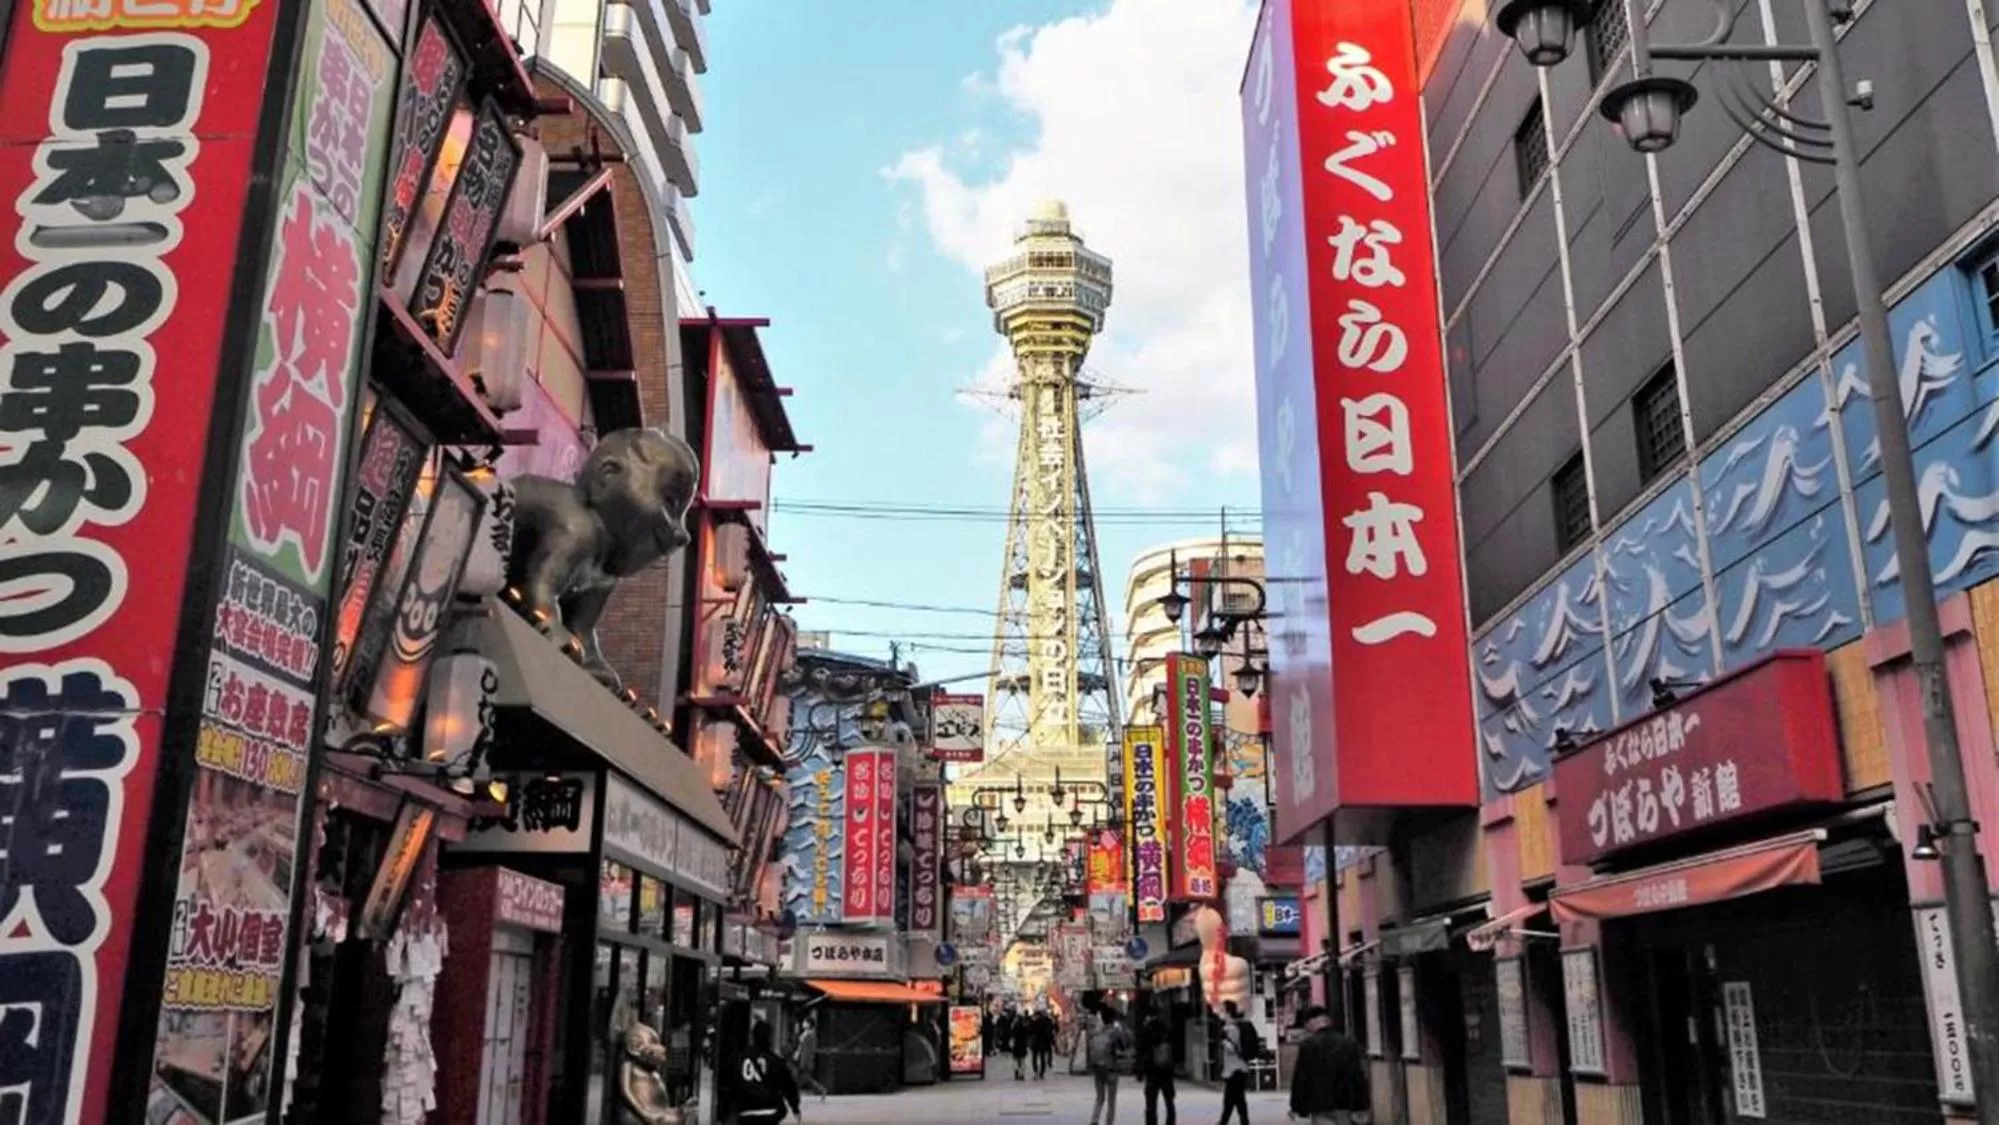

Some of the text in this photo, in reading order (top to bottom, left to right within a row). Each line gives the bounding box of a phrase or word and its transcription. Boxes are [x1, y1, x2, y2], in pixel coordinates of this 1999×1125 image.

[1316, 41, 1437, 645] ふぐなら日本一
